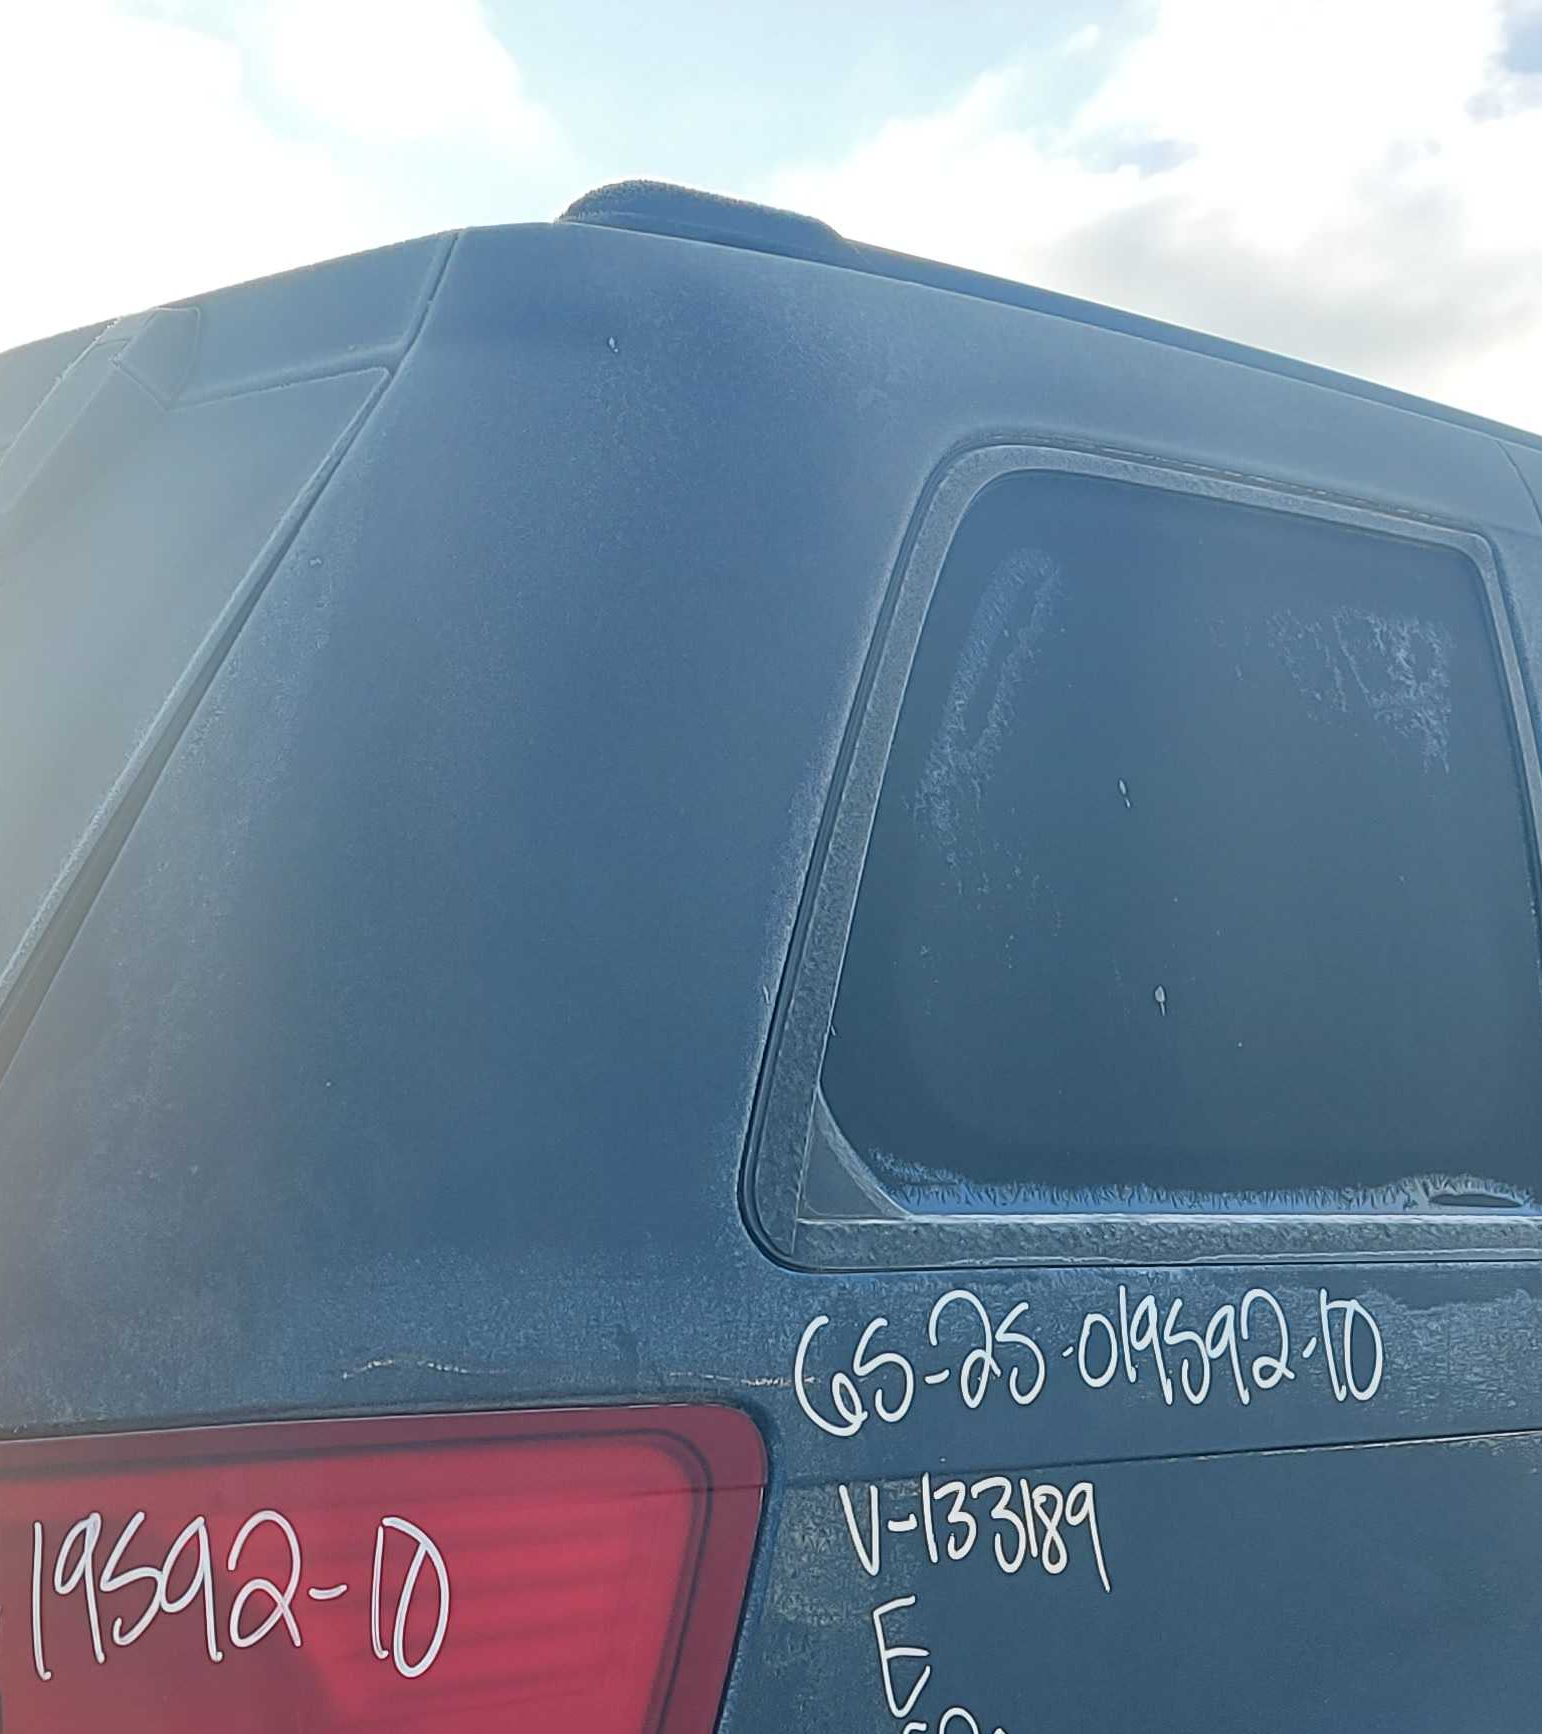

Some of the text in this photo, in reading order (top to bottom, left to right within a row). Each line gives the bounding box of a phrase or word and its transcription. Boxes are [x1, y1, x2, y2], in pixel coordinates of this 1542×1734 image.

[31, 1508, 451, 1681] 19592-10
[838, 1472, 1112, 1594] V-133189
[872, 1594, 931, 1718] E
